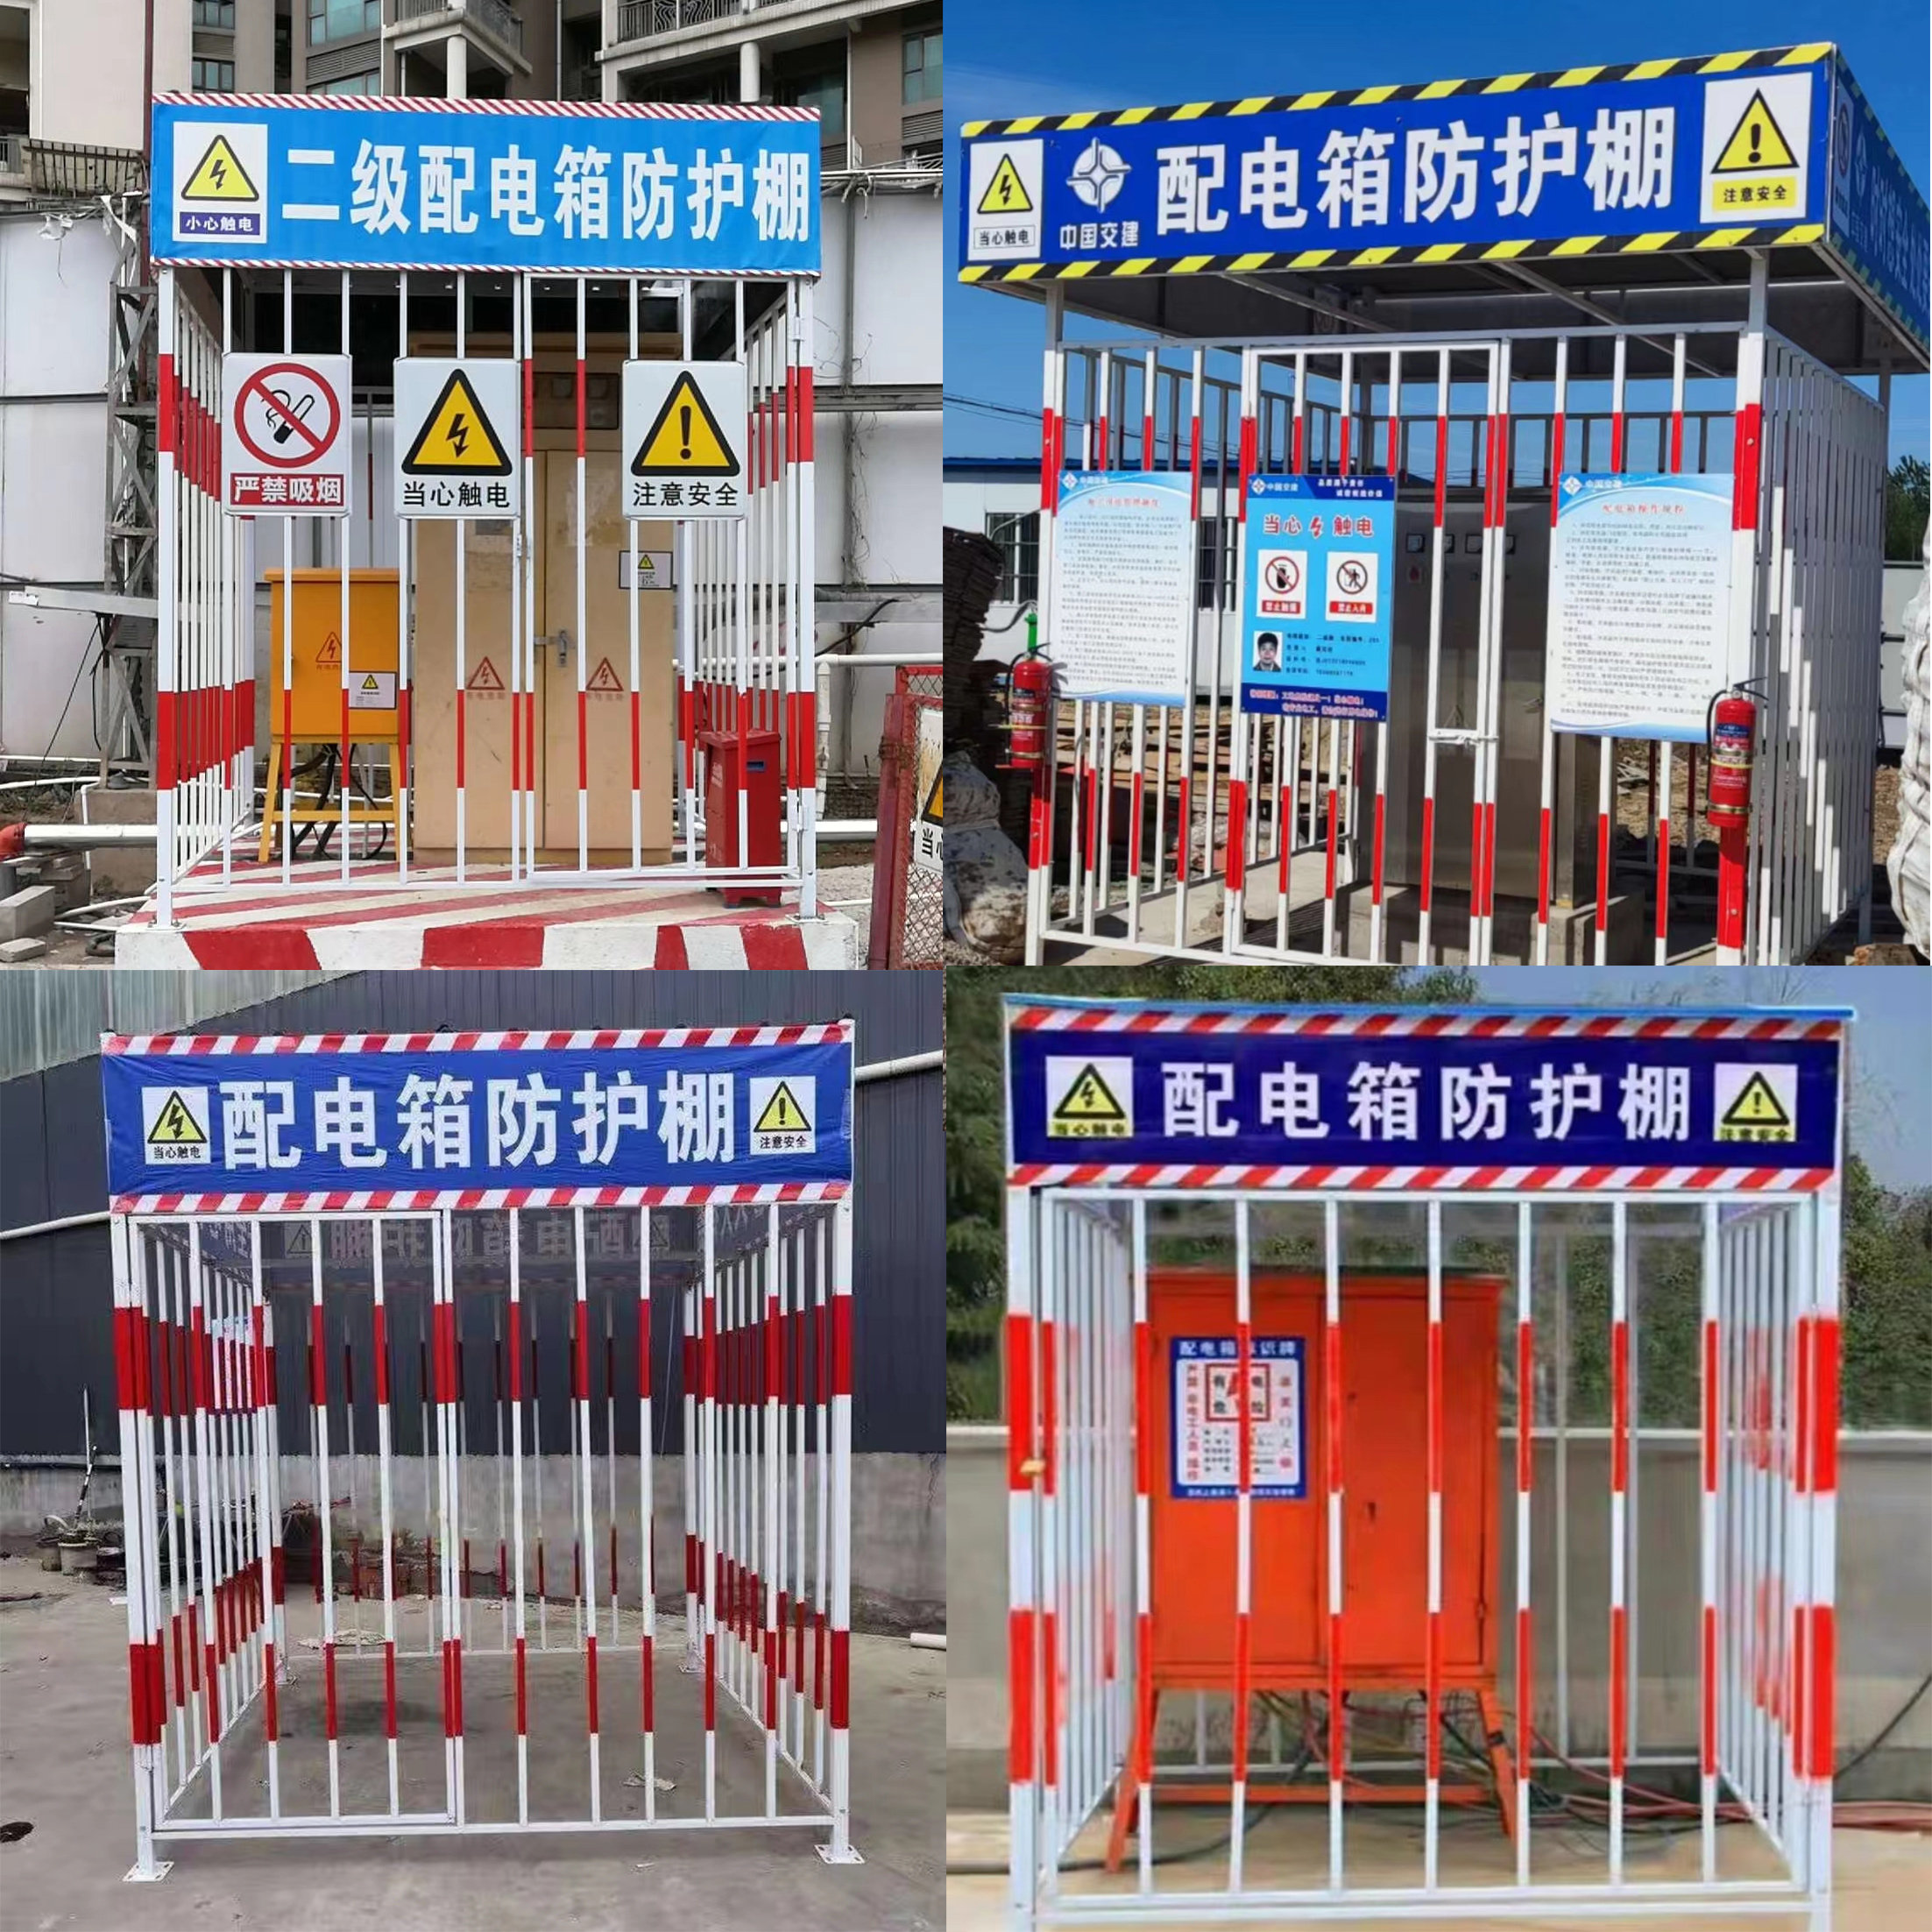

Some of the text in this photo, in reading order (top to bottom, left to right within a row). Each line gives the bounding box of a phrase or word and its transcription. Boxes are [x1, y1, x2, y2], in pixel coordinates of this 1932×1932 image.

[1156, 106, 1676, 236] 配电箱防护棚
[281, 138, 810, 243] 二级配电箱防护棚
[1723, 184, 1788, 203] 注意安全
[185, 216, 254, 233] 小心触电
[979, 229, 1030, 247] 当心触电
[1059, 221, 1139, 251] 中国交建
[233, 476, 342, 504] 严禁吸烟
[403, 481, 512, 509] 当心触电
[633, 481, 739, 507] 注意安全
[1263, 514, 1374, 537] 当心 触电
[1161, 1061, 1691, 1141] 配电箱防护棚
[219, 1070, 735, 1171] 配电箱防护棚
[153, 1145, 202, 1159] 当心触电
[760, 1135, 807, 1149] 注意安全
